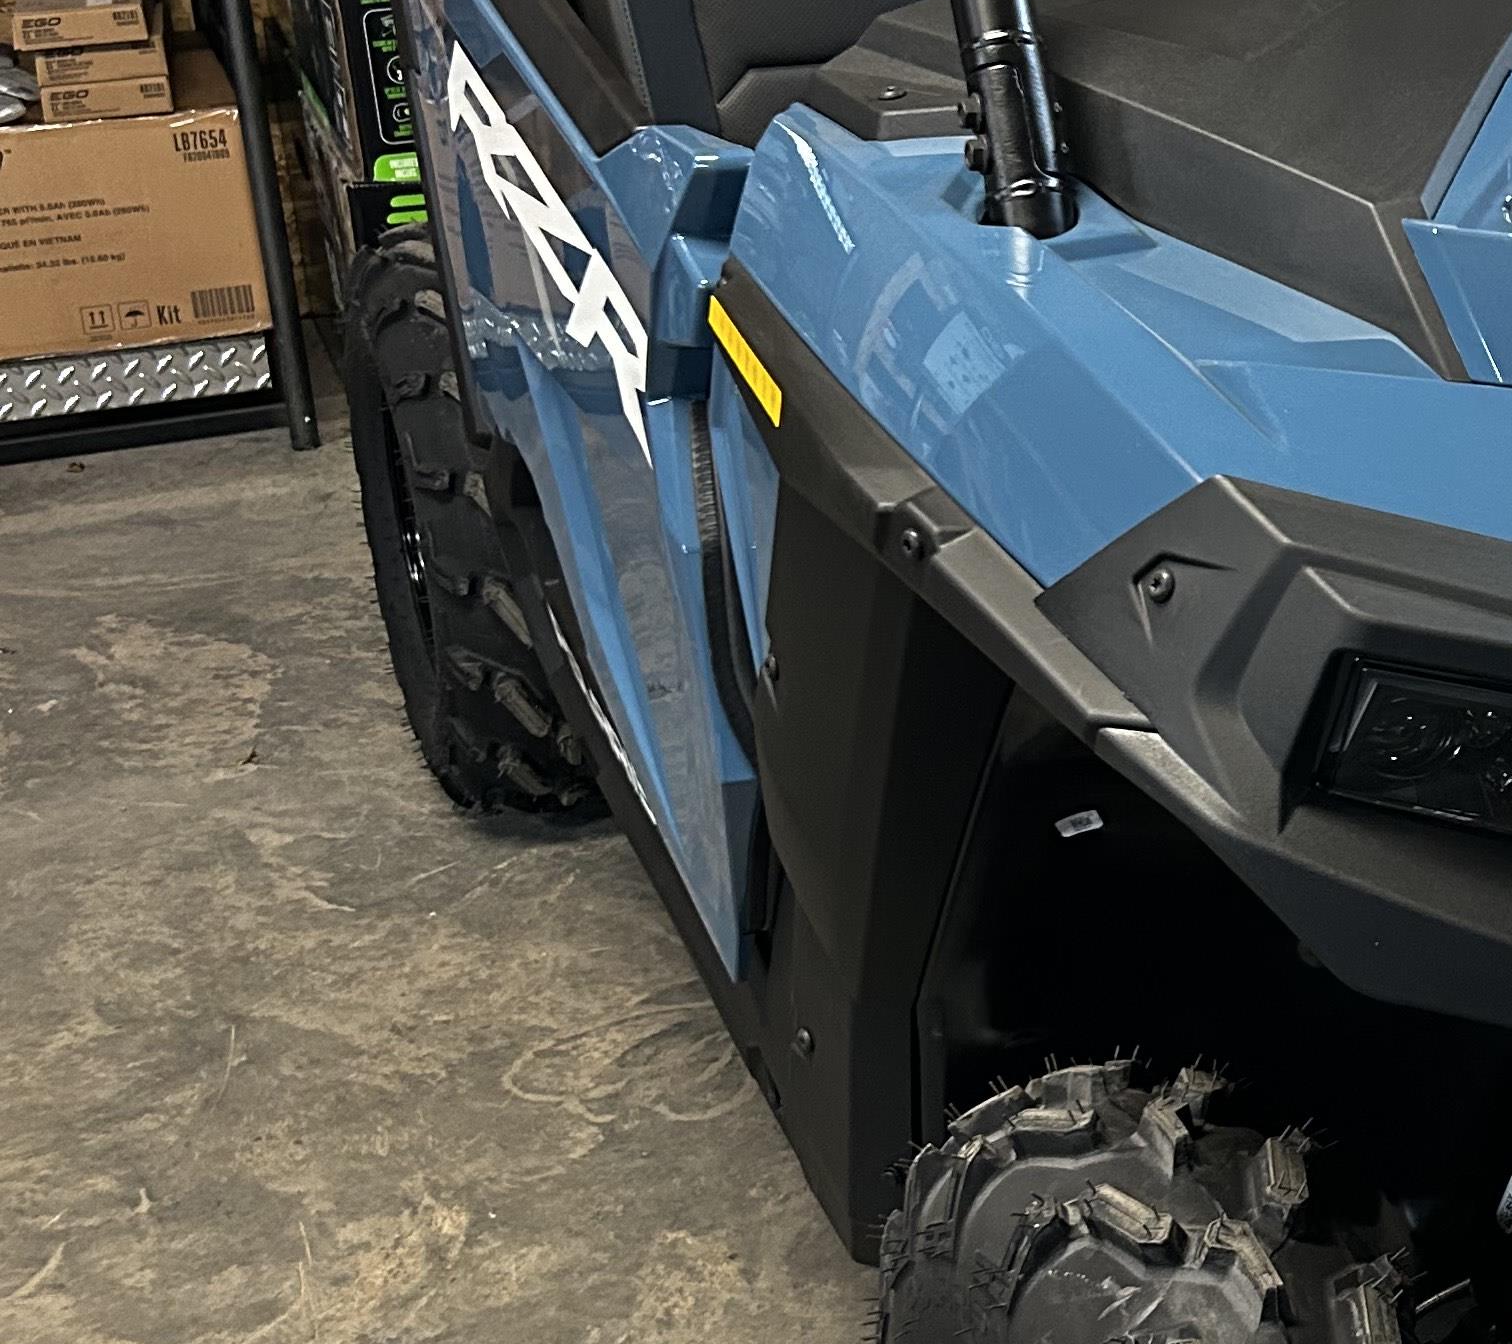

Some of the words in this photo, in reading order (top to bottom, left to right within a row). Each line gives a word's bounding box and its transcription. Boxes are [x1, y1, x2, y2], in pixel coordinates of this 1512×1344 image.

[21, 16, 62, 29] EGO
[50, 89, 90, 101] EGO
[172, 128, 229, 152] LB7654
[38, 234, 82, 245] VIETNAM
[447, 40, 654, 471] RZR
[156, 304, 182, 326] Kit
